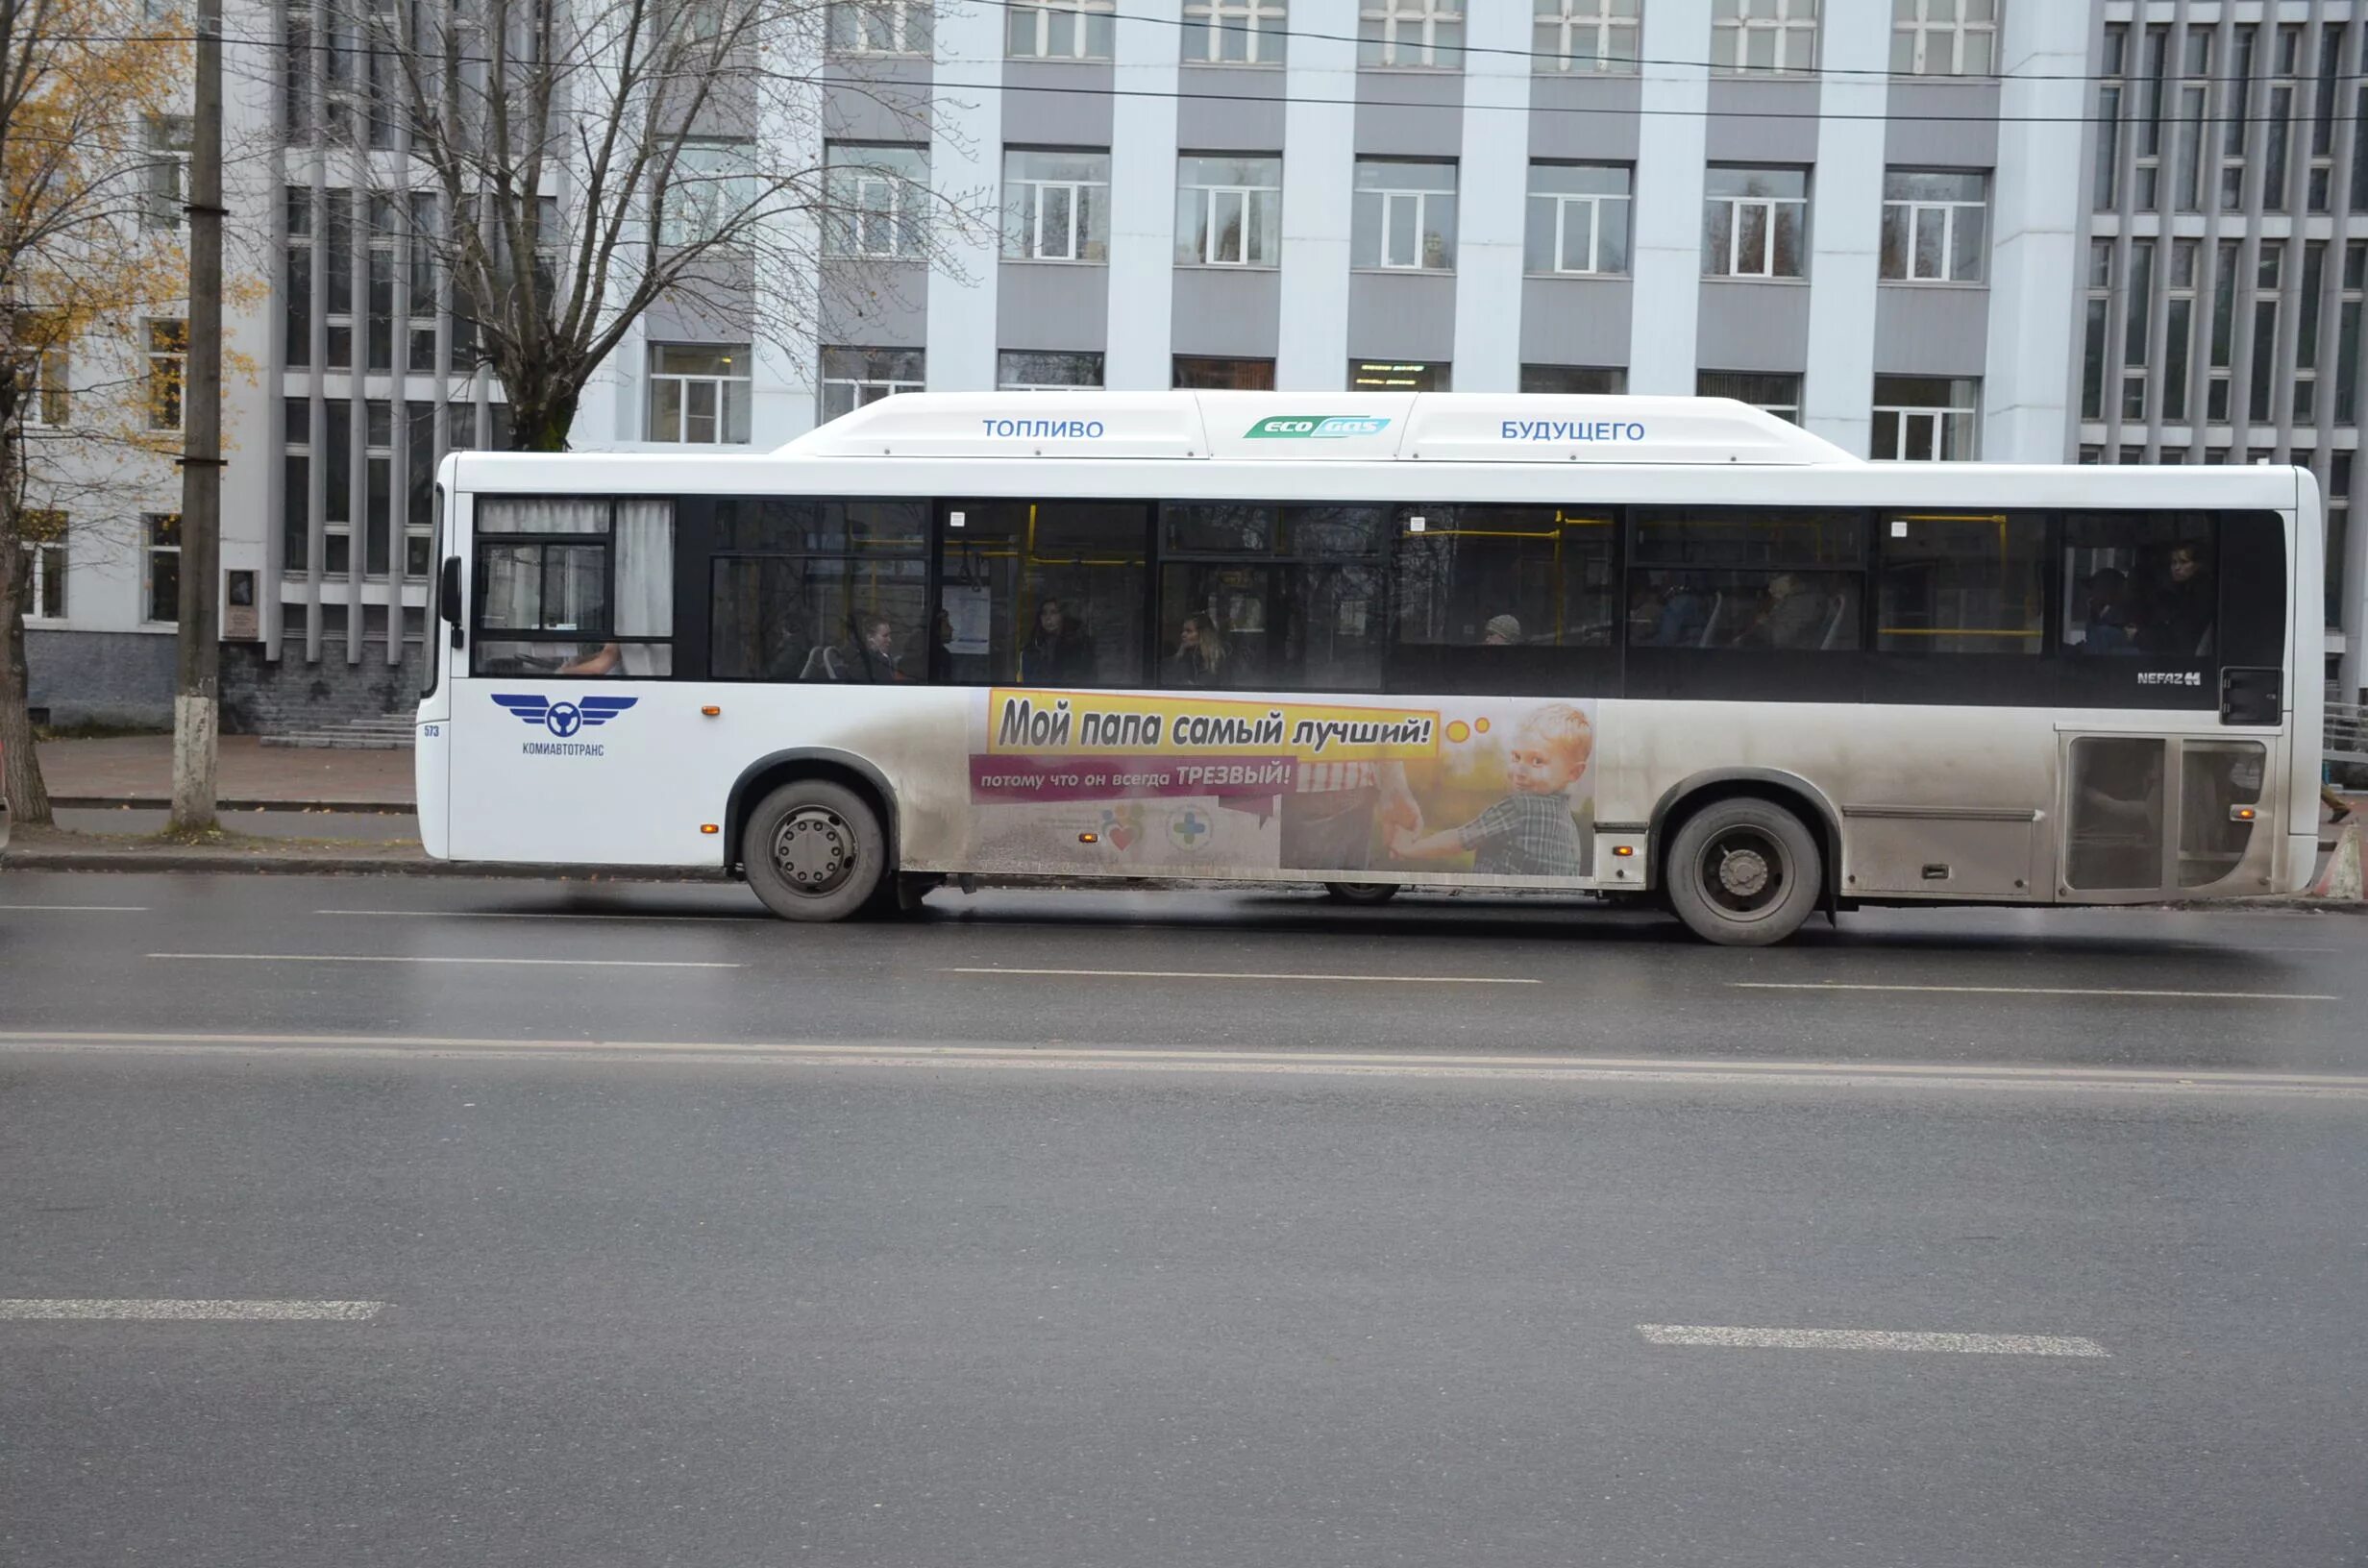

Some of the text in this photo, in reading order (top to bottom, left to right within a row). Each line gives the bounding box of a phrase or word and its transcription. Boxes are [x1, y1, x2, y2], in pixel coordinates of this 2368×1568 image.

[982, 419, 1104, 438] ТОПЛИВО
[1502, 421, 1644, 441] БУДУЩЕГО
[2137, 672, 2183, 685] NEFAZ
[424, 724, 439, 737] 573
[999, 698, 1431, 752] Мой папа самый лучший!
[522, 742, 604, 756] КОМИАВТОТРАНС
[981, 760, 1292, 790] потому что он всегда ТРЕЗВЫЙ!
